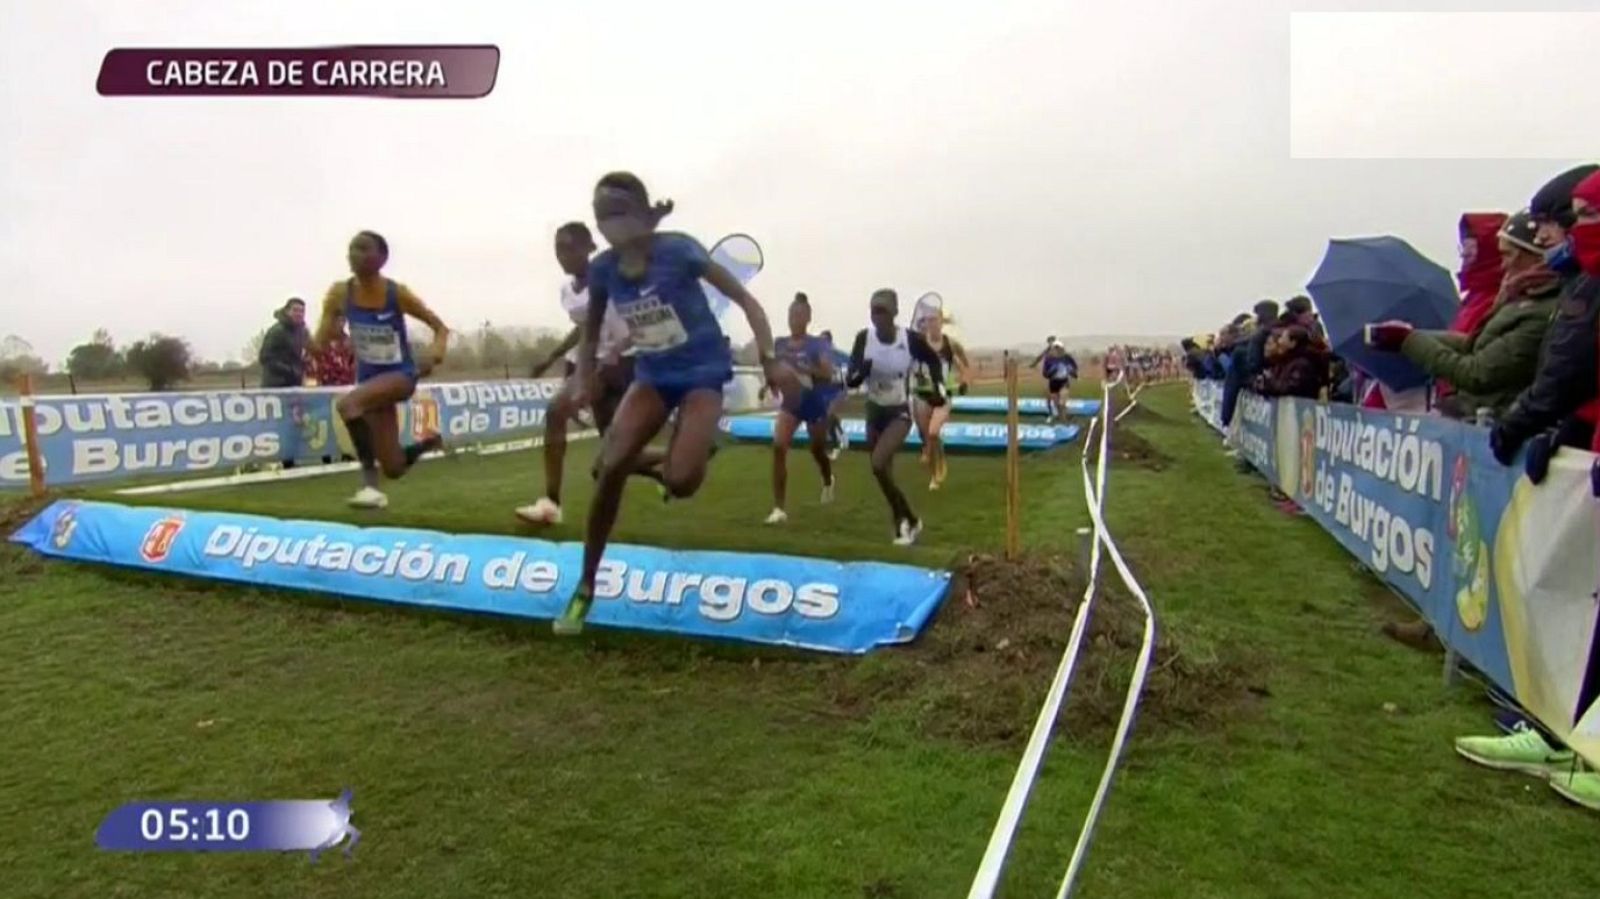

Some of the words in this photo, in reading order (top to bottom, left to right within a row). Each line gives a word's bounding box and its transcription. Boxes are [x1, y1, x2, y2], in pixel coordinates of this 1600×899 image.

[0, 394, 282, 444] iputación
[450, 409, 491, 434] de
[500, 406, 546, 429] Bur
[1315, 405, 1443, 500] Diputación
[0, 451, 47, 479] e
[72, 432, 280, 475] Burgos
[1315, 461, 1334, 512] de
[1336, 473, 1434, 589] Burgos
[204, 524, 470, 584] Diputación
[482, 552, 560, 592] de
[594, 559, 839, 621] Burgos
